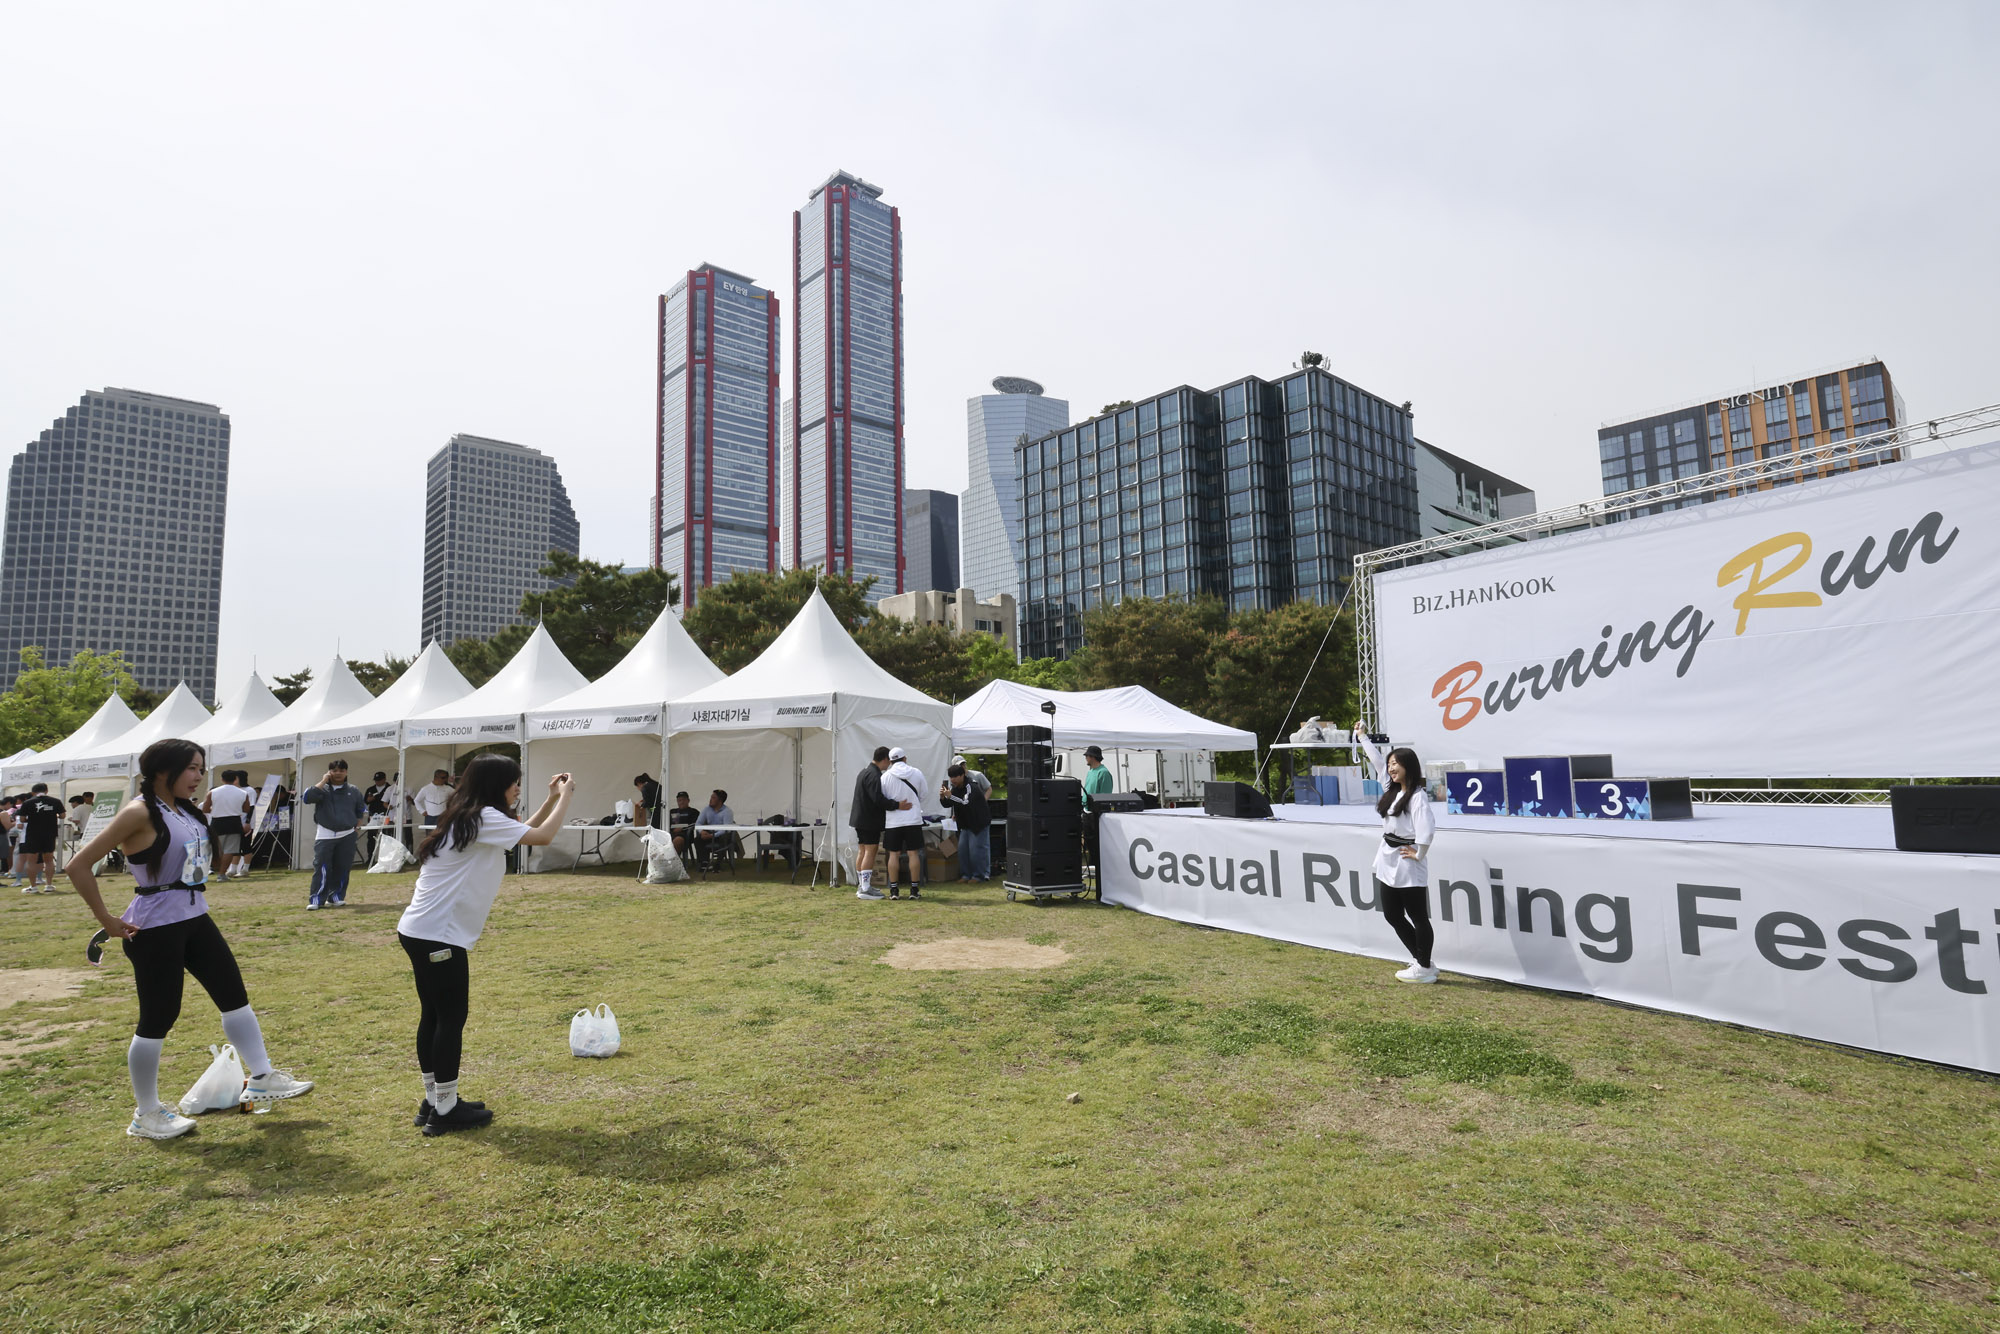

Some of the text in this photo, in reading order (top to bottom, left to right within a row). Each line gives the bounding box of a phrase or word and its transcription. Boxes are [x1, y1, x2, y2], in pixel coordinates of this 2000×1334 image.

[723, 281, 735, 292] EY
[1431, 511, 1960, 732] Burning Run
[691, 708, 751, 724] 사회자대기실
[776, 707, 809, 716] BURNING
[810, 706, 827, 714] RUN
[541, 718, 592, 731] 사회자대기실
[614, 714, 658, 724] BURNING RUN
[427, 728, 450, 737] PRESS
[451, 727, 473, 735] ROOM
[322, 737, 341, 747] PRESS
[342, 735, 361, 744] ROOM
[1466, 777, 1484, 807] 2
[1530, 770, 1544, 800] 1
[1600, 783, 1623, 816] 3
[1128, 837, 2000, 994] Casual Runing Fest
